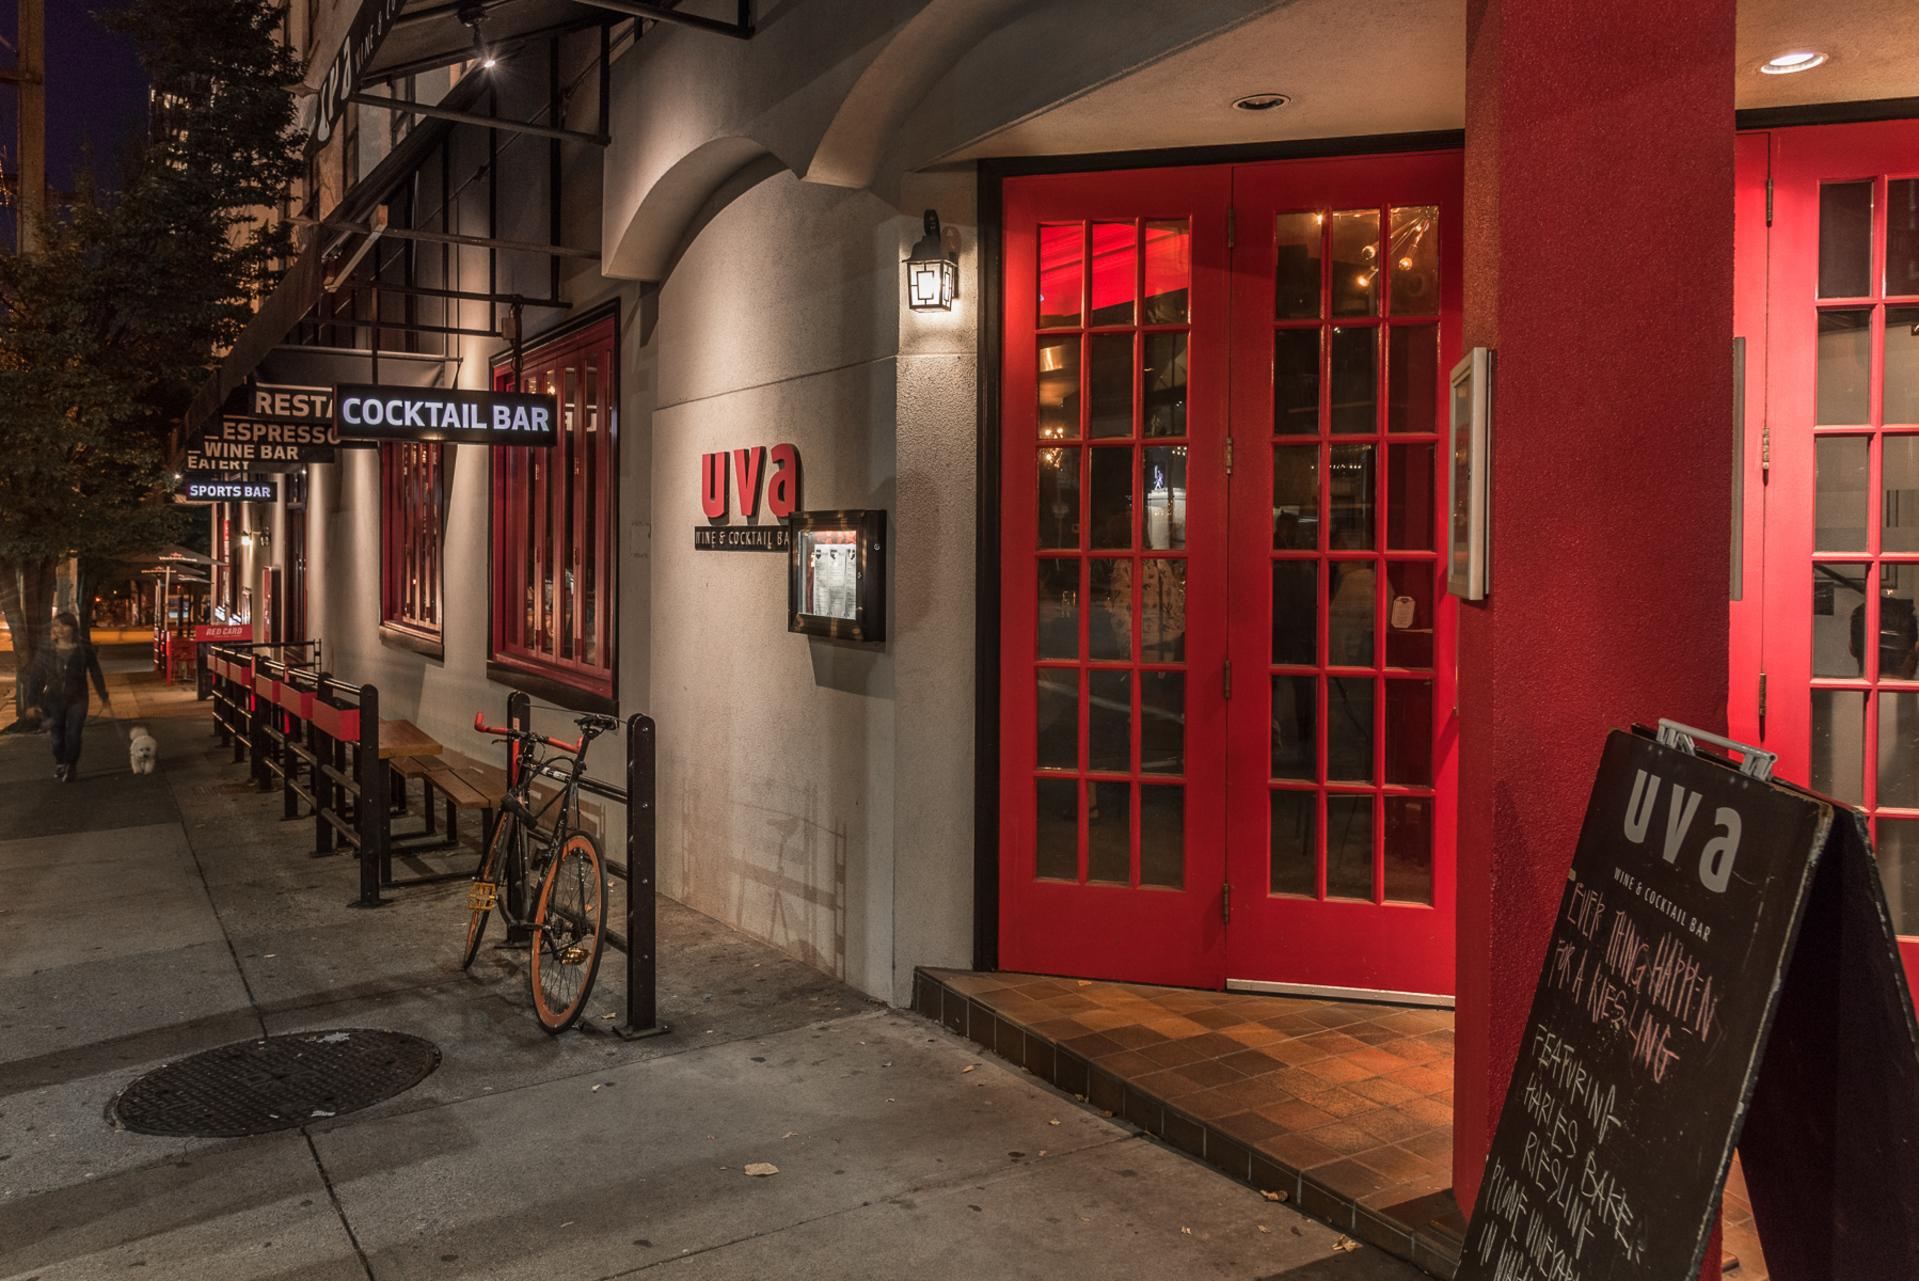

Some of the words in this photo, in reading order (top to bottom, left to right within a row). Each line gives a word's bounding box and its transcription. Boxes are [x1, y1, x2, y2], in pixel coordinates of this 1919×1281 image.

[343, 398, 488, 429] COCKTAIL
[492, 404, 550, 432] BAR
[204, 441, 255, 459] WINE
[260, 445, 299, 460] BAR
[189, 485, 242, 497] SPORTS
[244, 486, 271, 498] BAR
[702, 443, 799, 519] uva
[695, 531, 717, 545] WINE
[719, 531, 726, 545] &
[728, 531, 773, 546] COCKTAIL
[777, 531, 789, 546] BA
[206, 628, 222, 636] RED
[222, 627, 243, 635] CARD
[1623, 768, 1742, 893] uva
[1614, 867, 1635, 890] WINE
[1636, 882, 1643, 896] &
[1644, 887, 1687, 927] COCKTAIL
[1689, 917, 1711, 942] BAR
[1572, 949, 1588, 1005] A
[1532, 1023, 1622, 1145] FEATURING
[1521, 1131, 1595, 1260] RIESLING
[1478, 1220, 1499, 1267] IN
[1526, 1207, 1581, 1281] VINEYAR
